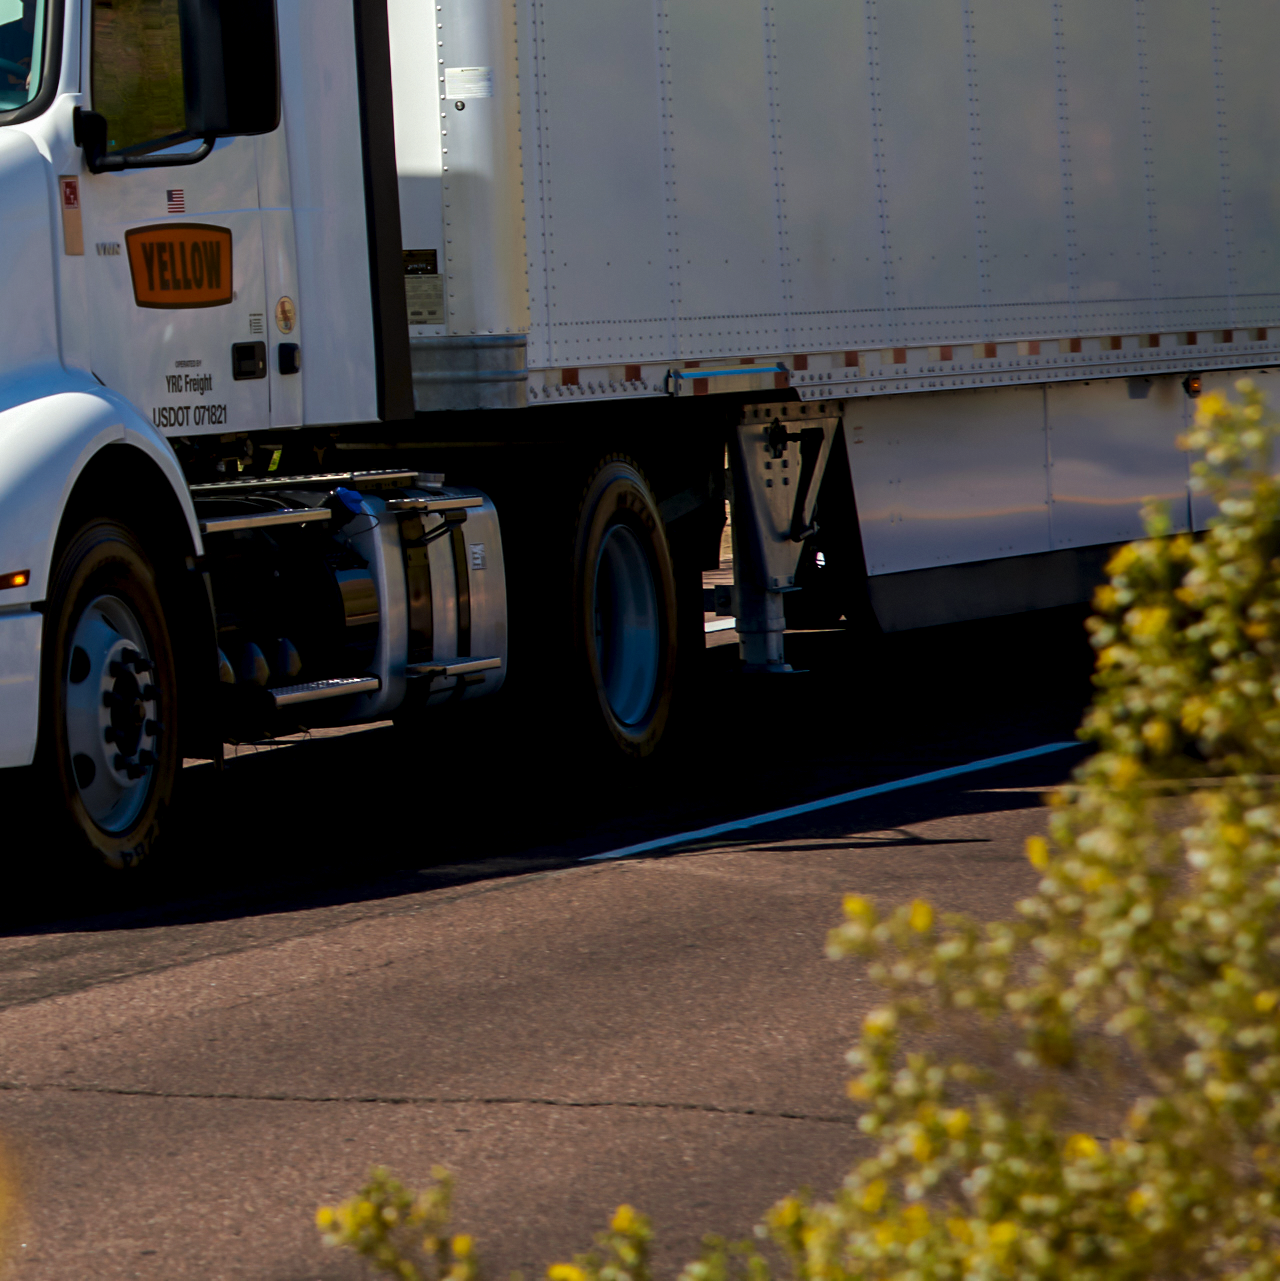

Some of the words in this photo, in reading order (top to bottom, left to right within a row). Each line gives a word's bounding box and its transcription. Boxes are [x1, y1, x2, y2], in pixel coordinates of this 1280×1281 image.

[141, 241, 221, 291] YELLOW
[166, 375, 182, 393] YRC
[185, 374, 212, 395] Freight
[153, 406, 191, 428] USDOT
[194, 404, 227, 426] 071821
